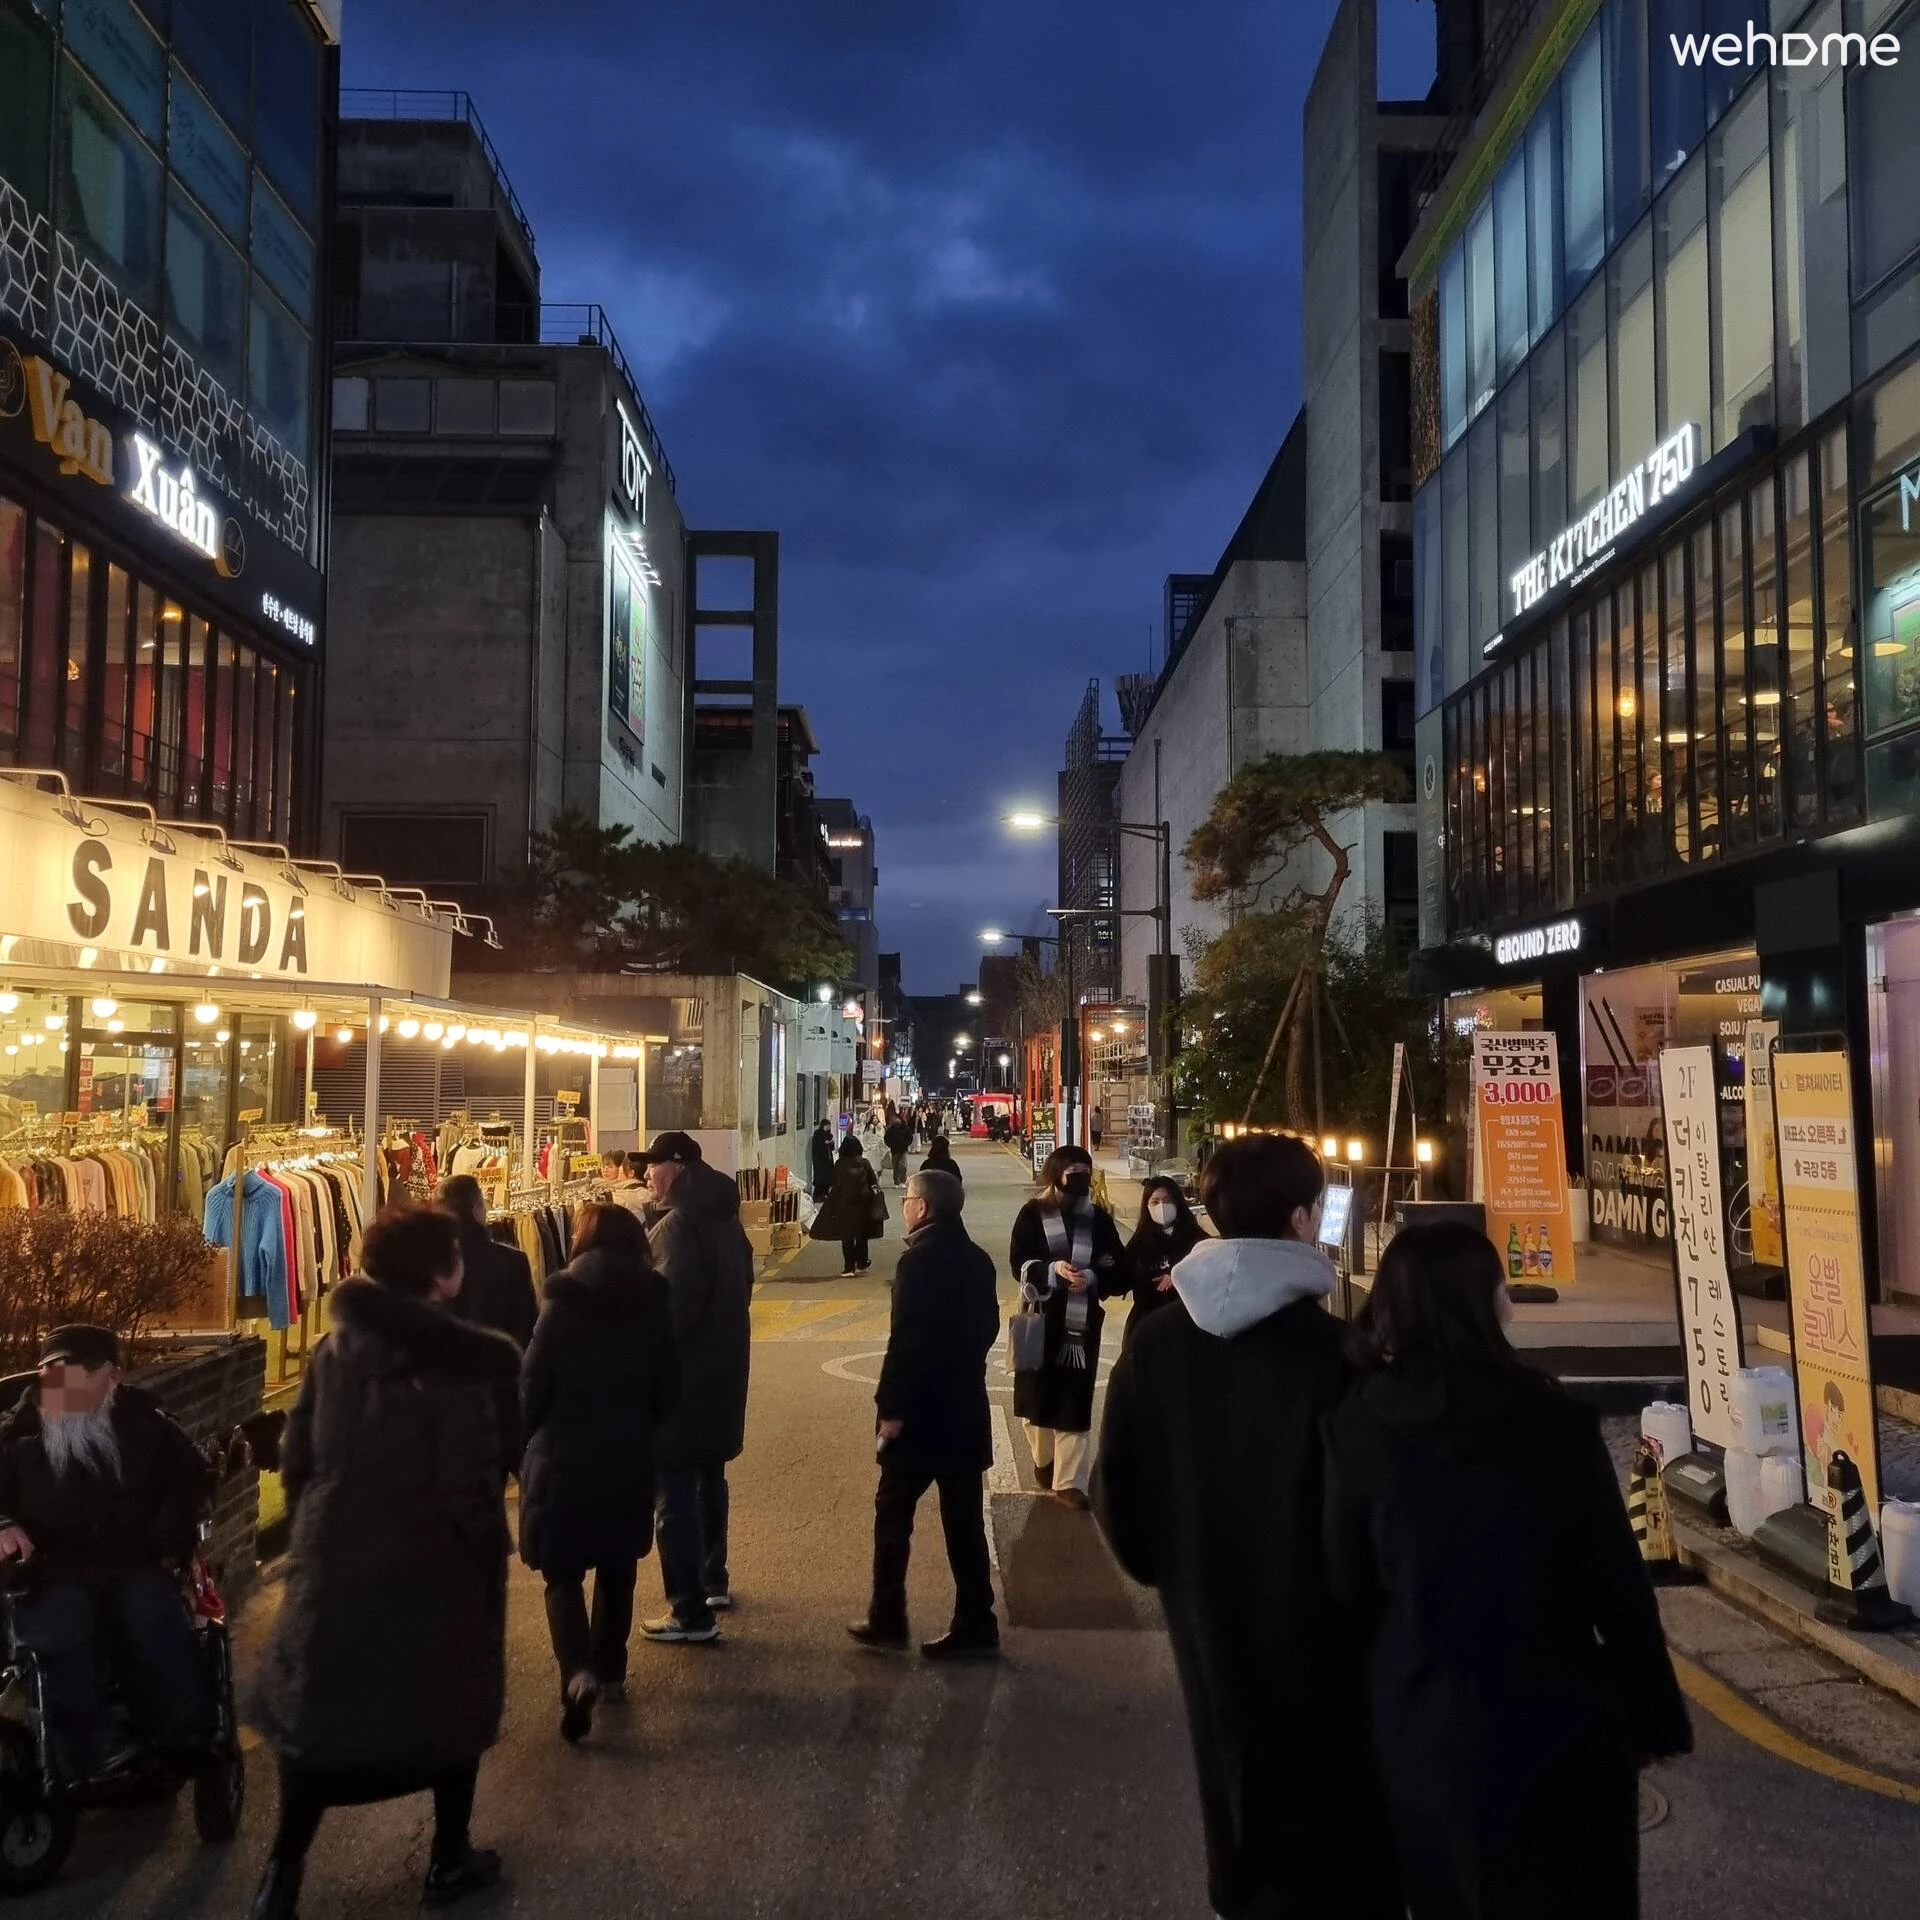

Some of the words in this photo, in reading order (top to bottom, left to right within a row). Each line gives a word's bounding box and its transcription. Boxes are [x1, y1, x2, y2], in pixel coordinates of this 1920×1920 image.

[617, 398, 652, 525] TOM
[132, 433, 217, 559] Xuân
[1512, 549, 1548, 616] THE
[1549, 464, 1644, 588] KITCHEN
[1649, 422, 1694, 507] 750
[67, 839, 308, 974] SANDA
[1497, 929, 1545, 964] GROUND
[1546, 920, 1580, 954] ZERO
[1715, 976, 1748, 993] CASUAL
[1480, 1038, 1549, 1051] 국산병맥주
[1720, 1020, 1740, 1036] SOJU
[1750, 1032, 1765, 1051] NEW
[1482, 1055, 1551, 1076] 무조건
[1751, 1067, 1767, 1086] SIZE
[1679, 1066, 1697, 1099] 2F
[1807, 1125, 1837, 1145] 오른쪽
[1803, 1160, 1819, 1179] 극장
[1820, 1161, 1838, 1181] 5층
[1593, 1188, 1648, 1234] DAMN
[1808, 1252, 1843, 1306] 운빨
[1802, 1299, 1860, 1361] 로맨스
